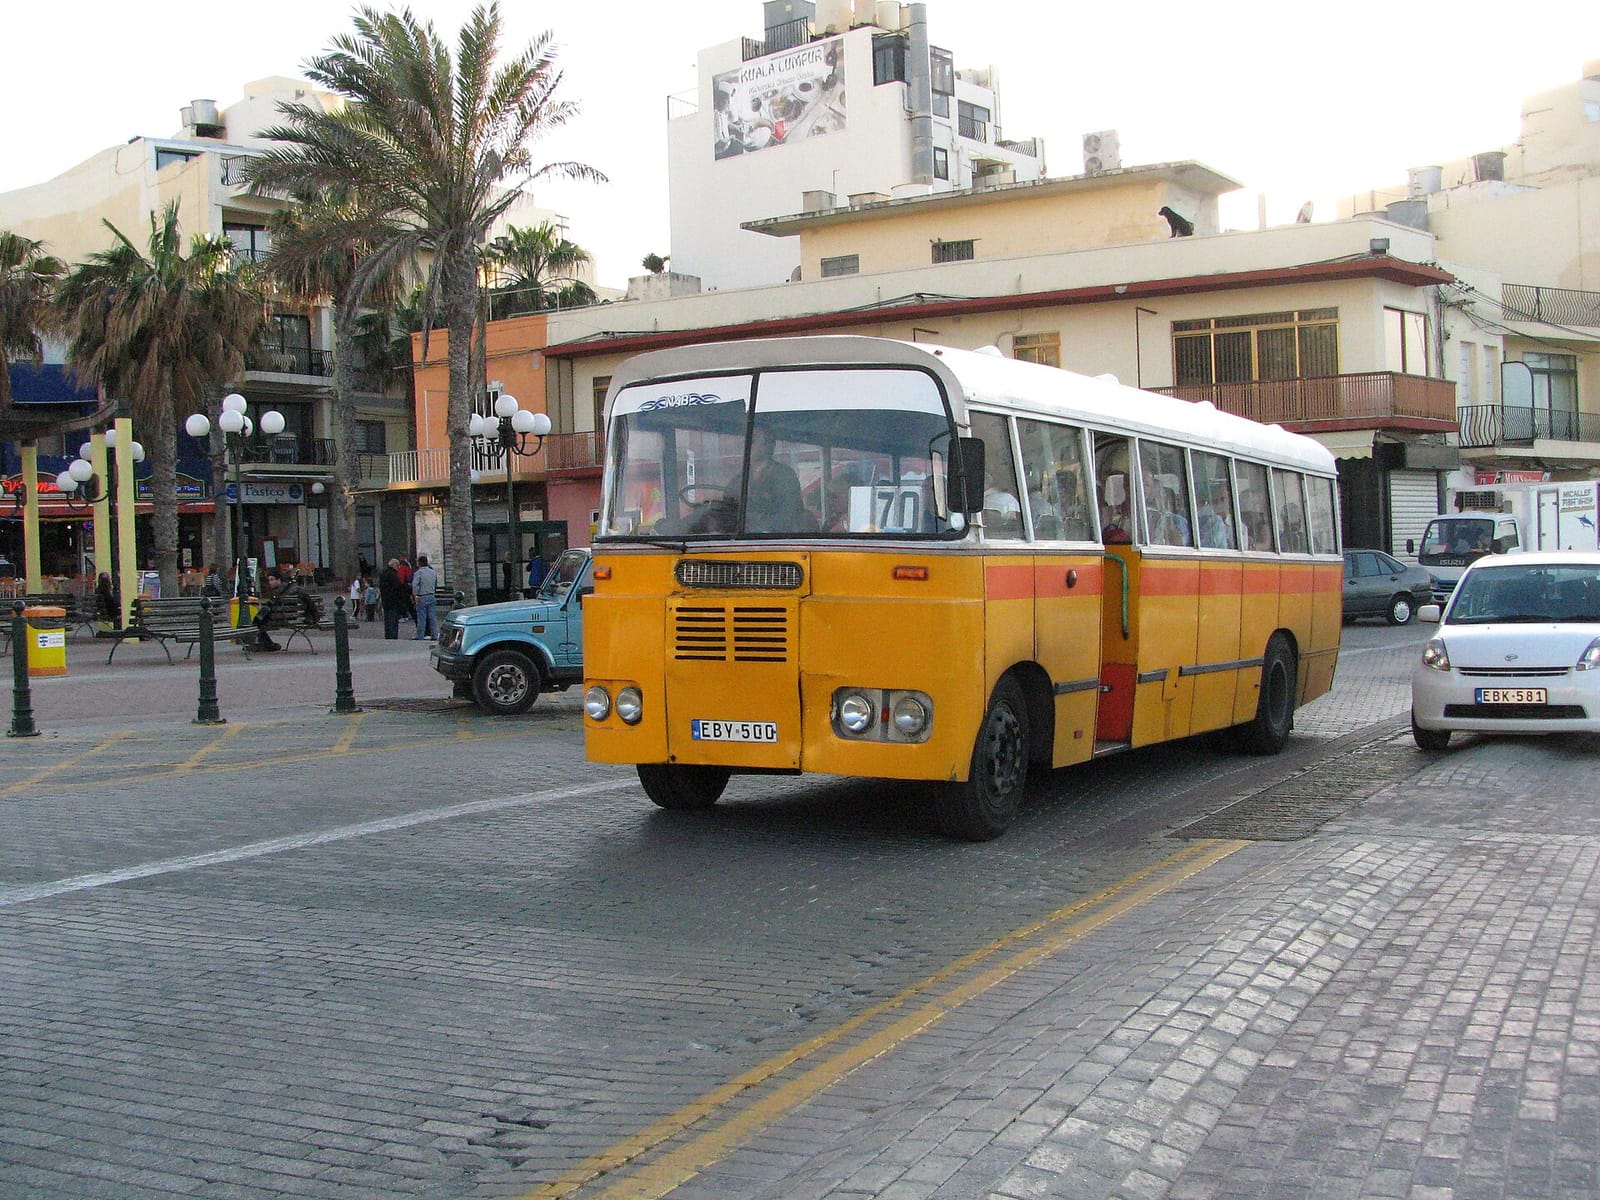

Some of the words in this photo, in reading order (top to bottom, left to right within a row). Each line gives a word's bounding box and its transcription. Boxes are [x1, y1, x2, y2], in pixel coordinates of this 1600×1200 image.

[740, 63, 775, 83] KUALA
[778, 48, 823, 74] LUMPUR
[877, 491, 919, 532] 70
